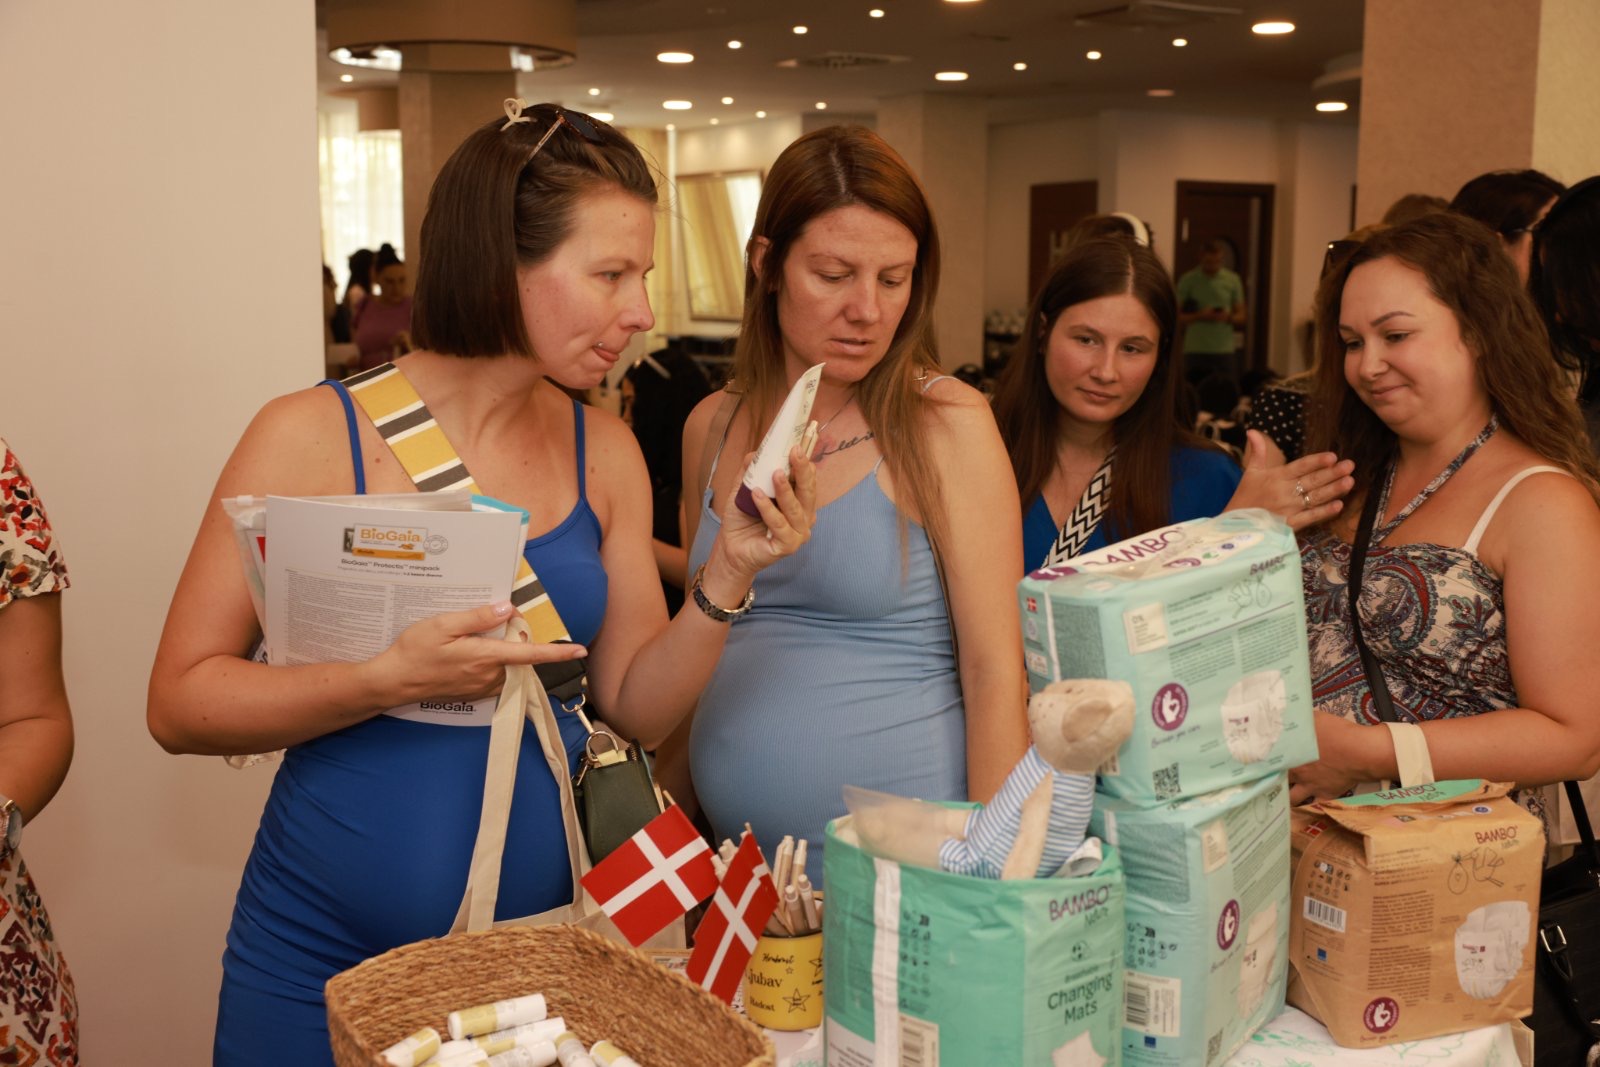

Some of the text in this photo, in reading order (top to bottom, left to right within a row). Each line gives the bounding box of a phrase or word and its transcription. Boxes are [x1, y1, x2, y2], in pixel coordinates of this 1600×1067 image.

[360, 527, 421, 543] BioGaia
[420, 701, 474, 712] BioGaia
[1376, 784, 1437, 800] BAMBO
[1475, 825, 1517, 844] BAMBO
[1049, 884, 1110, 922] BAMBO
[1047, 973, 1113, 1010] Changing
[1064, 1000, 1098, 1025] Mats
